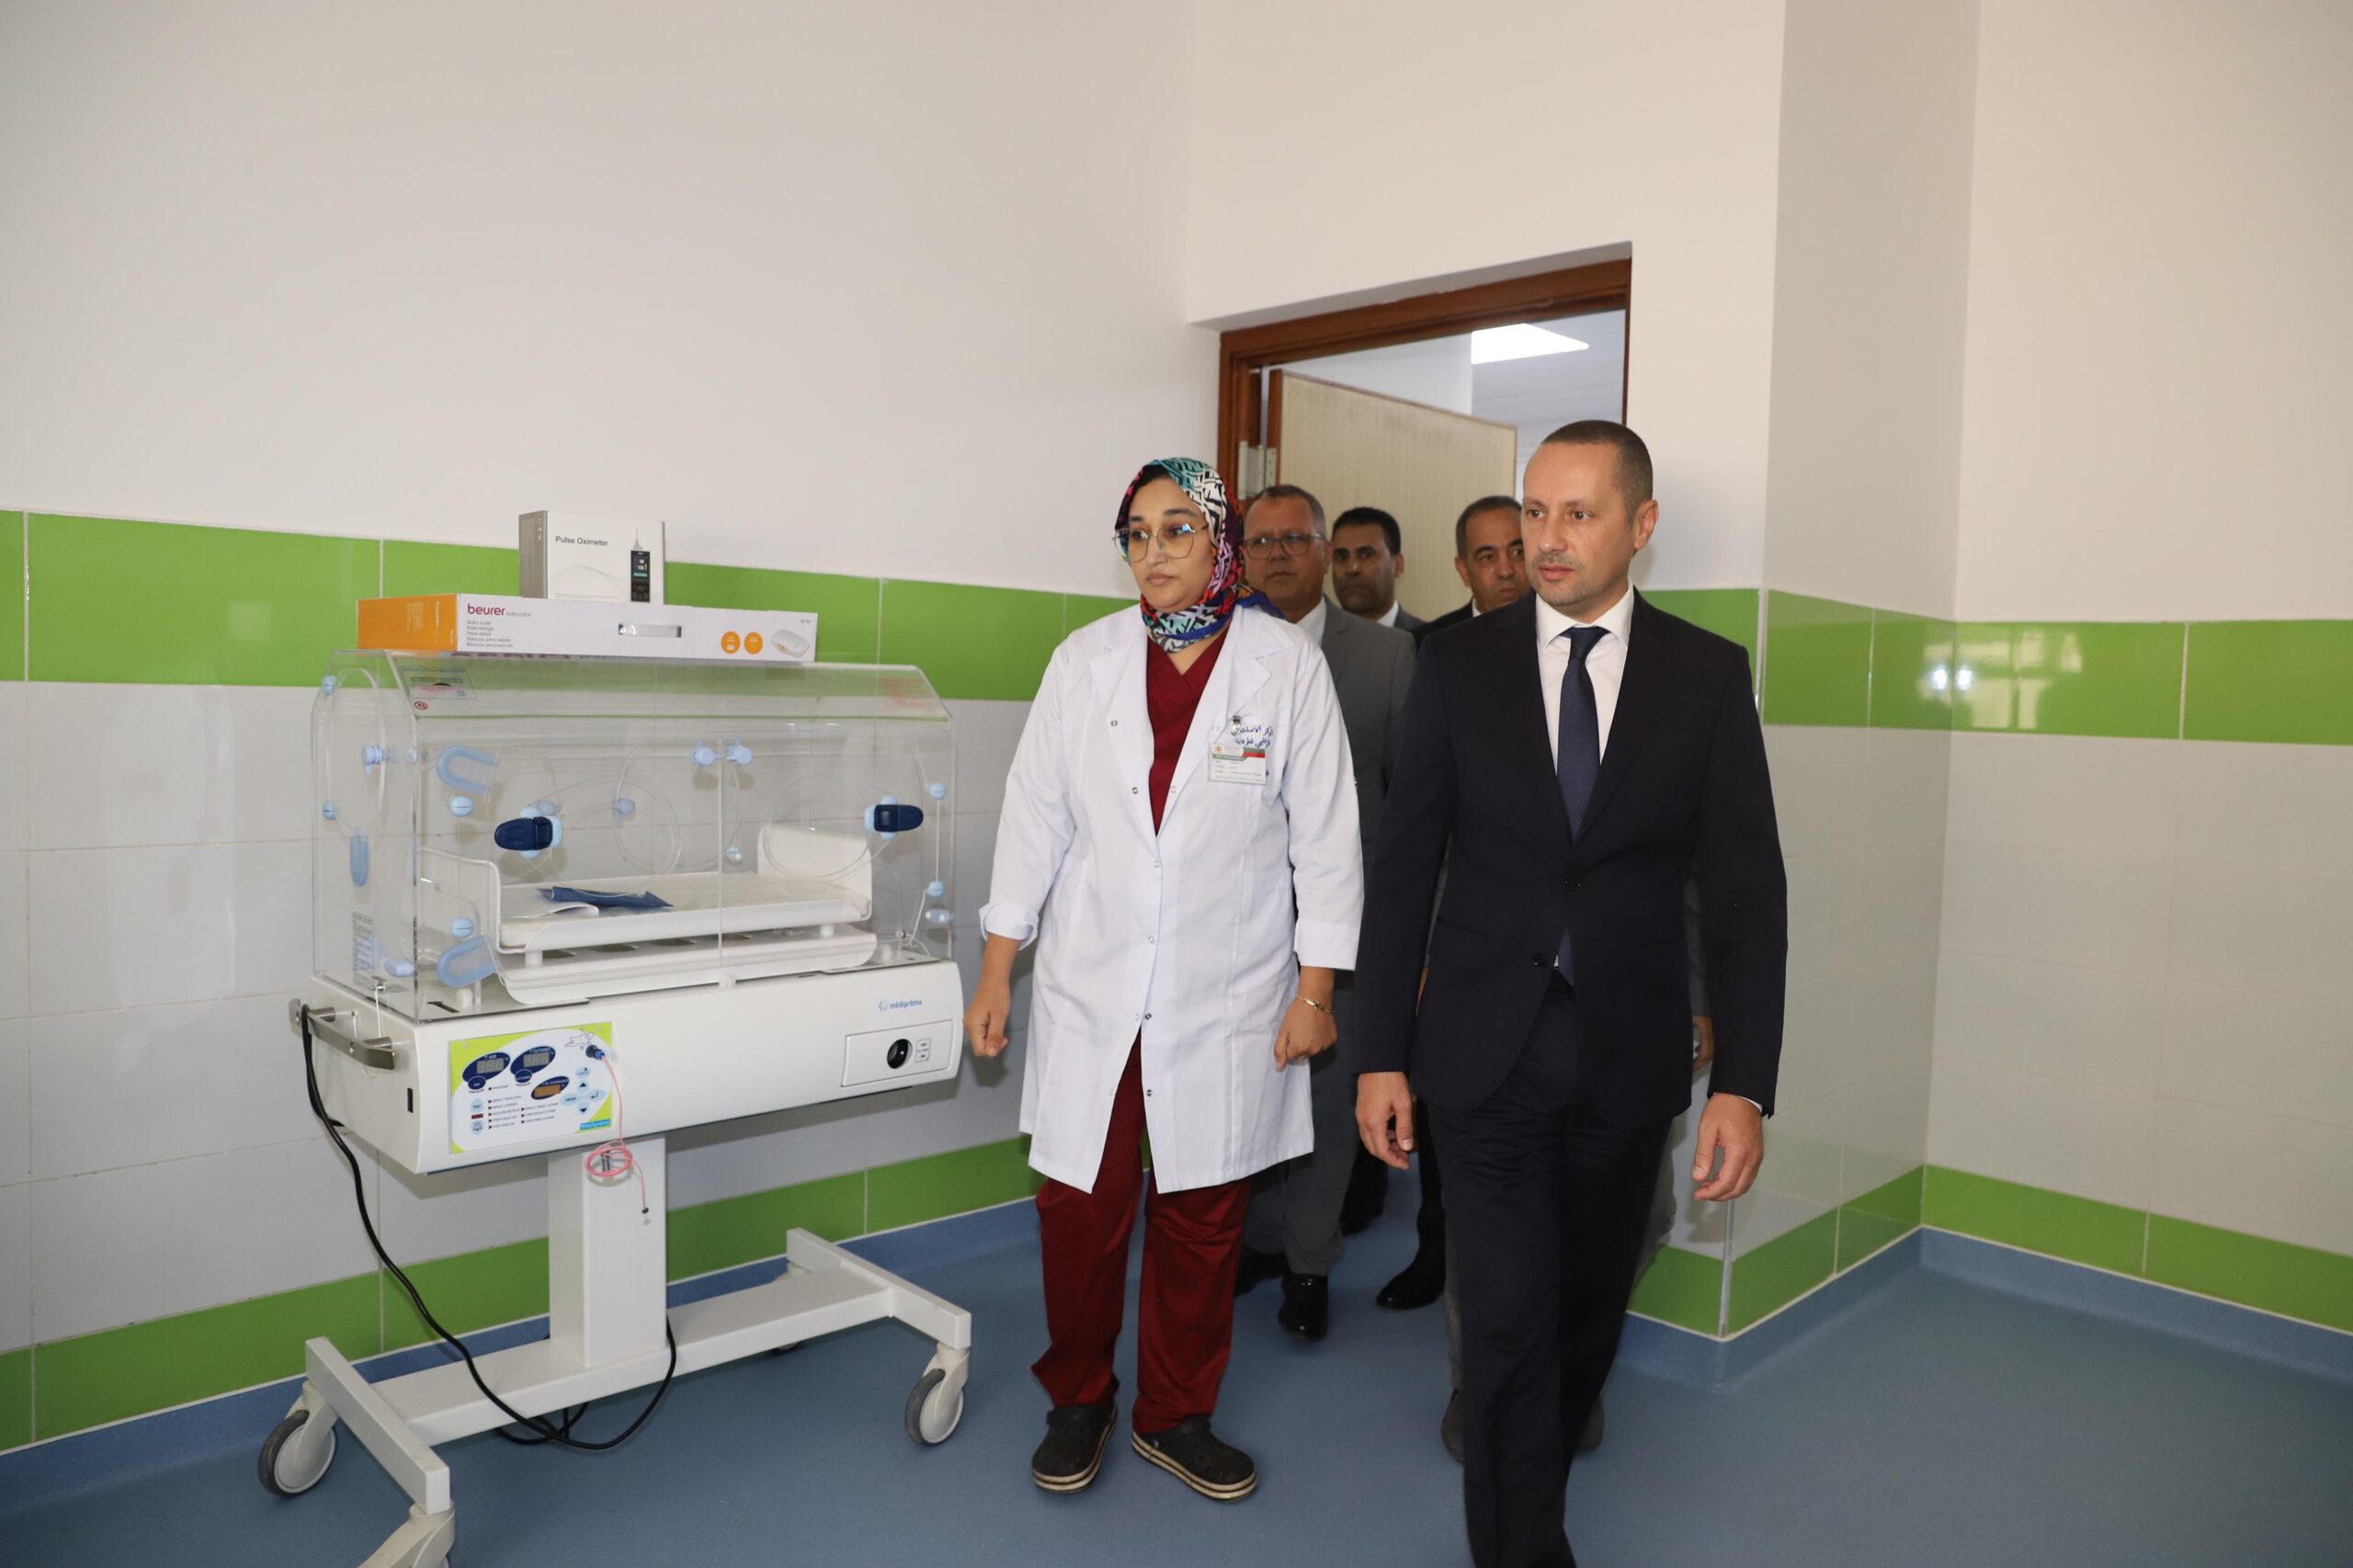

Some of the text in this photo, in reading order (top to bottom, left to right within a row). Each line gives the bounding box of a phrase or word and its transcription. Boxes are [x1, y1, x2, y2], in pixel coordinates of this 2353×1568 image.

[555, 536, 608, 547] Pulse Oximeter
[467, 603, 506, 616] beurer
